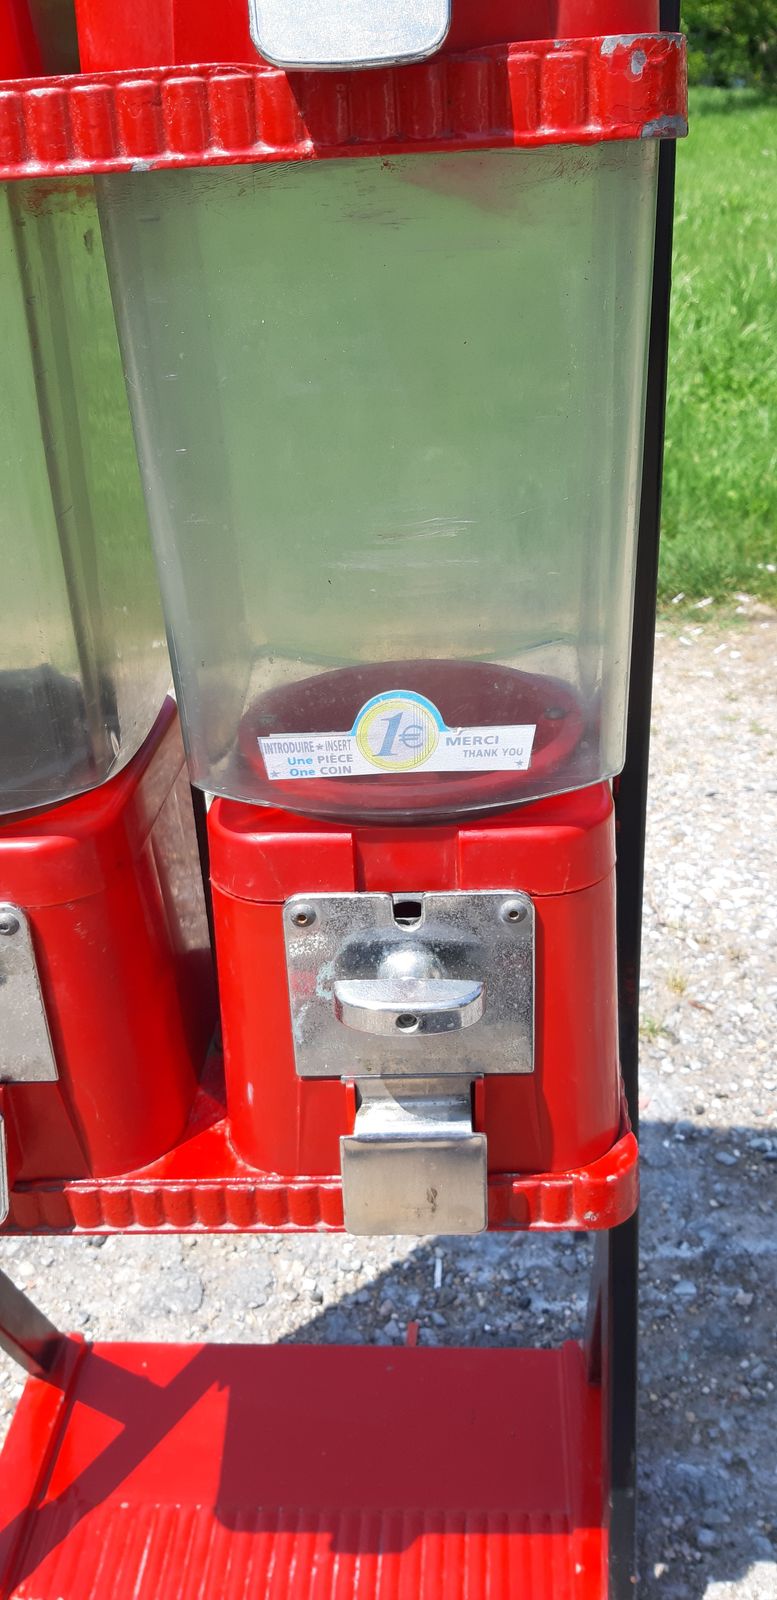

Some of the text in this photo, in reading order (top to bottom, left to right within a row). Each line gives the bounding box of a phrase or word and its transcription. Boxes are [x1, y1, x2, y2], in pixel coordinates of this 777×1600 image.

[263, 739, 352, 754] INTRODUIRE INSERT
[445, 735, 499, 747] MERCI
[463, 747, 524, 758] THANK YOU
[287, 752, 353, 766] Une PIÈCE
[289, 765, 352, 777] One COIN
